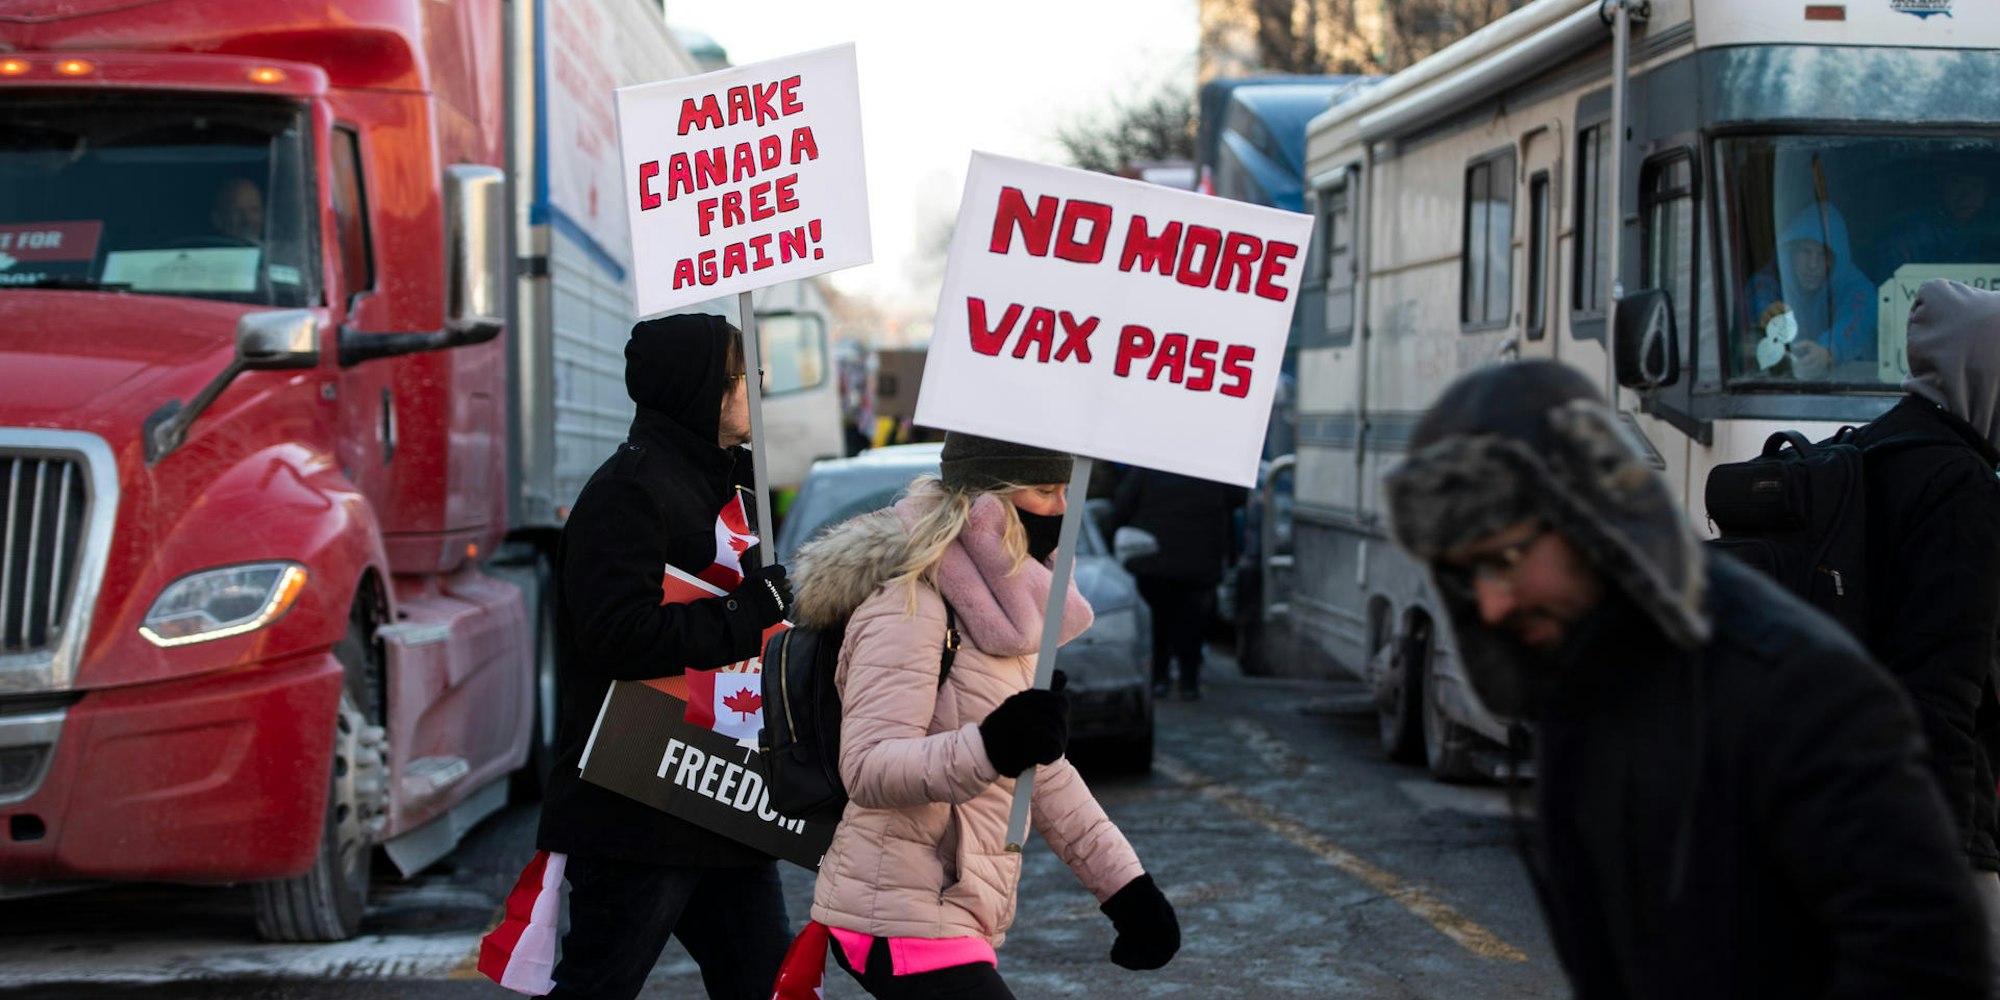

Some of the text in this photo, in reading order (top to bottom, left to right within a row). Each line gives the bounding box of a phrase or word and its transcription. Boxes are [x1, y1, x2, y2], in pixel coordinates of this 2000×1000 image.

[677, 75, 803, 135] MAKE
[640, 126, 818, 211] CANADA
[17, 230, 63, 250] FOR
[698, 173, 799, 236] FREE
[673, 219, 823, 290] AGAIN!
[989, 187, 1298, 302] NO MORE
[967, 297, 1255, 398] VAX PASS
